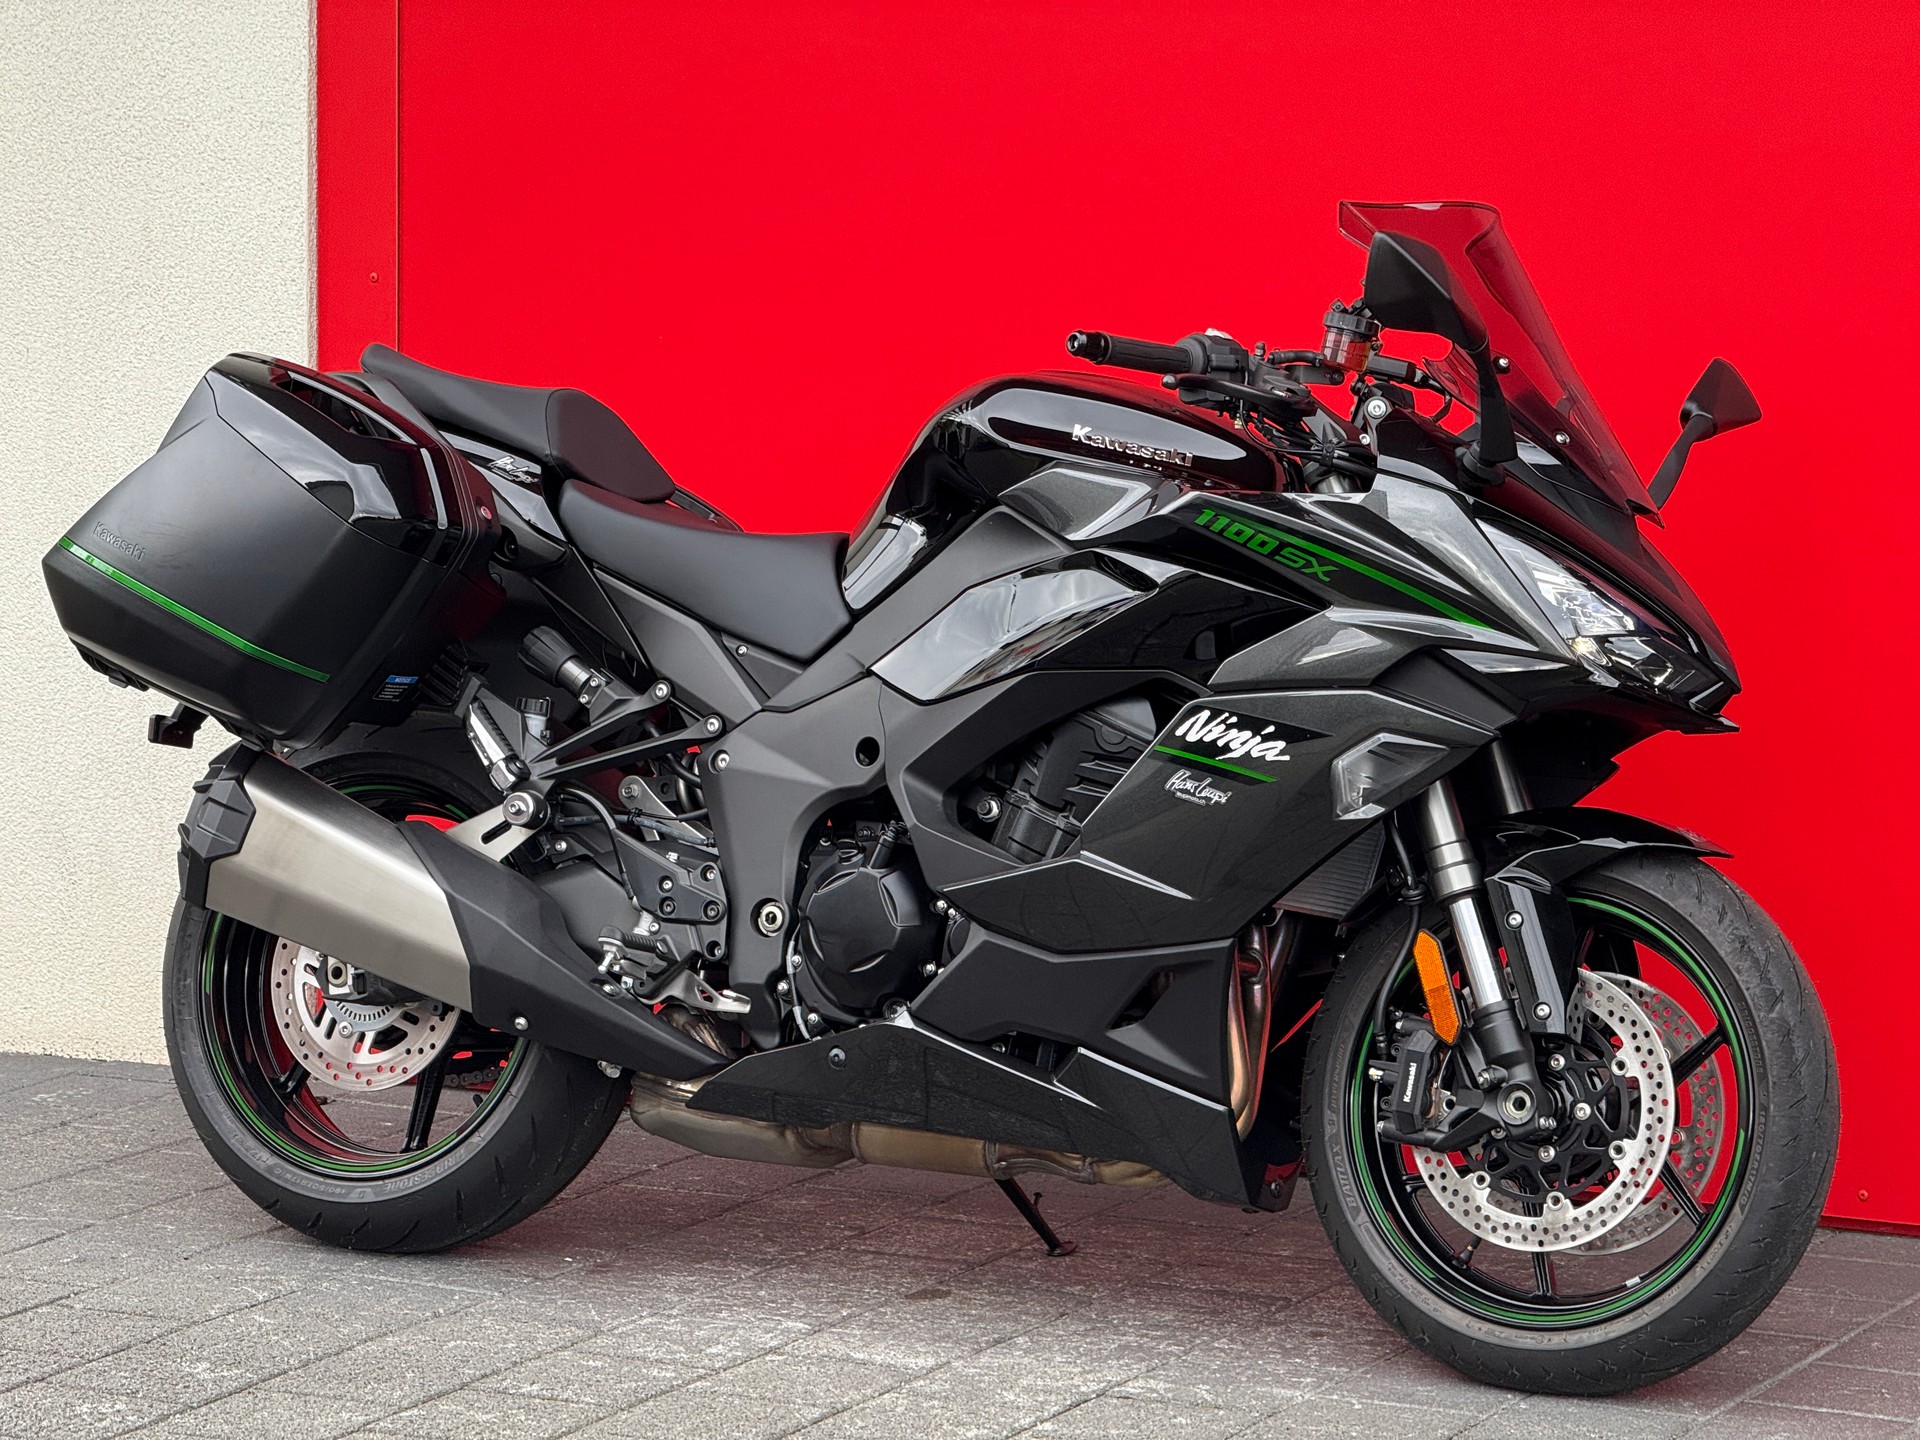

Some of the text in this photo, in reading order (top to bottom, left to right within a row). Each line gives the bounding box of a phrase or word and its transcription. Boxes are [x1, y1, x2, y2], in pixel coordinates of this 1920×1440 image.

[1072, 423, 1193, 467] Kawasaki
[93, 521, 147, 562] Kawasaki
[1175, 709, 1291, 761] Ninja
[1403, 1062, 1418, 1103] Kawasaki
[1331, 1143, 1358, 1208] BATTLAX
